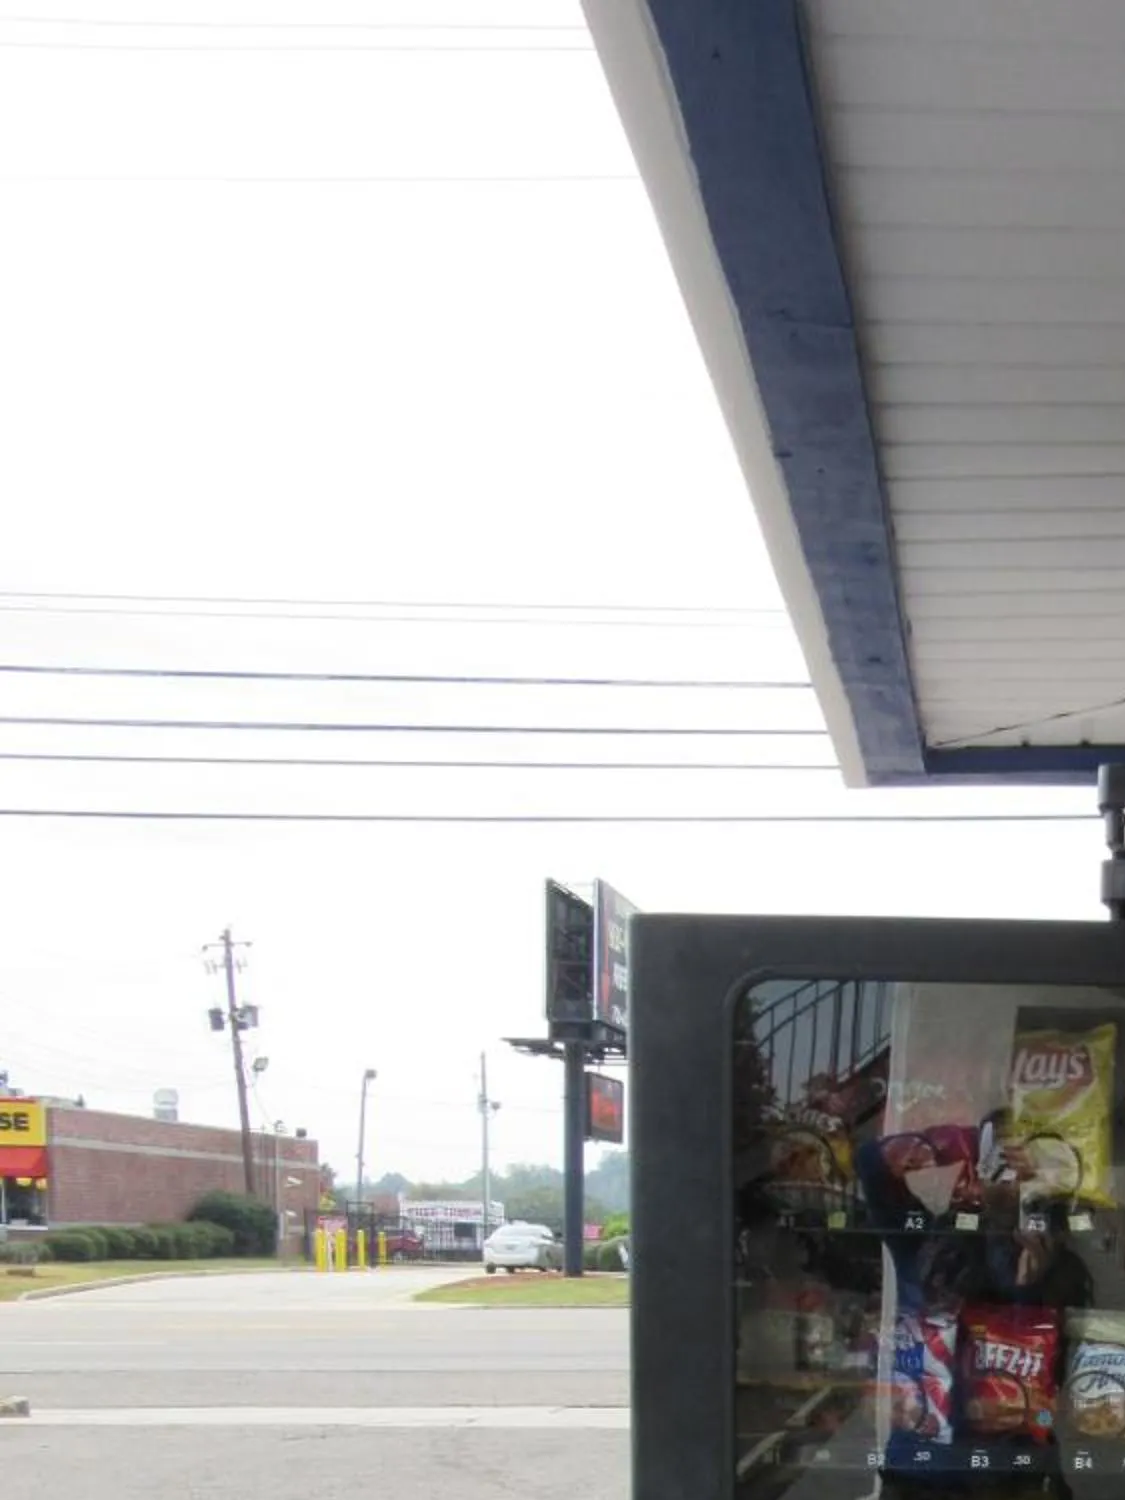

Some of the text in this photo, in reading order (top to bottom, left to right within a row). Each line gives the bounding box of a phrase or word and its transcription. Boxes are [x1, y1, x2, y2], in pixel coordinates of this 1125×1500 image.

[904, 1216, 926, 1230] A2
[970, 1455, 990, 1469] B3
[1073, 1456, 1093, 1470] B4
